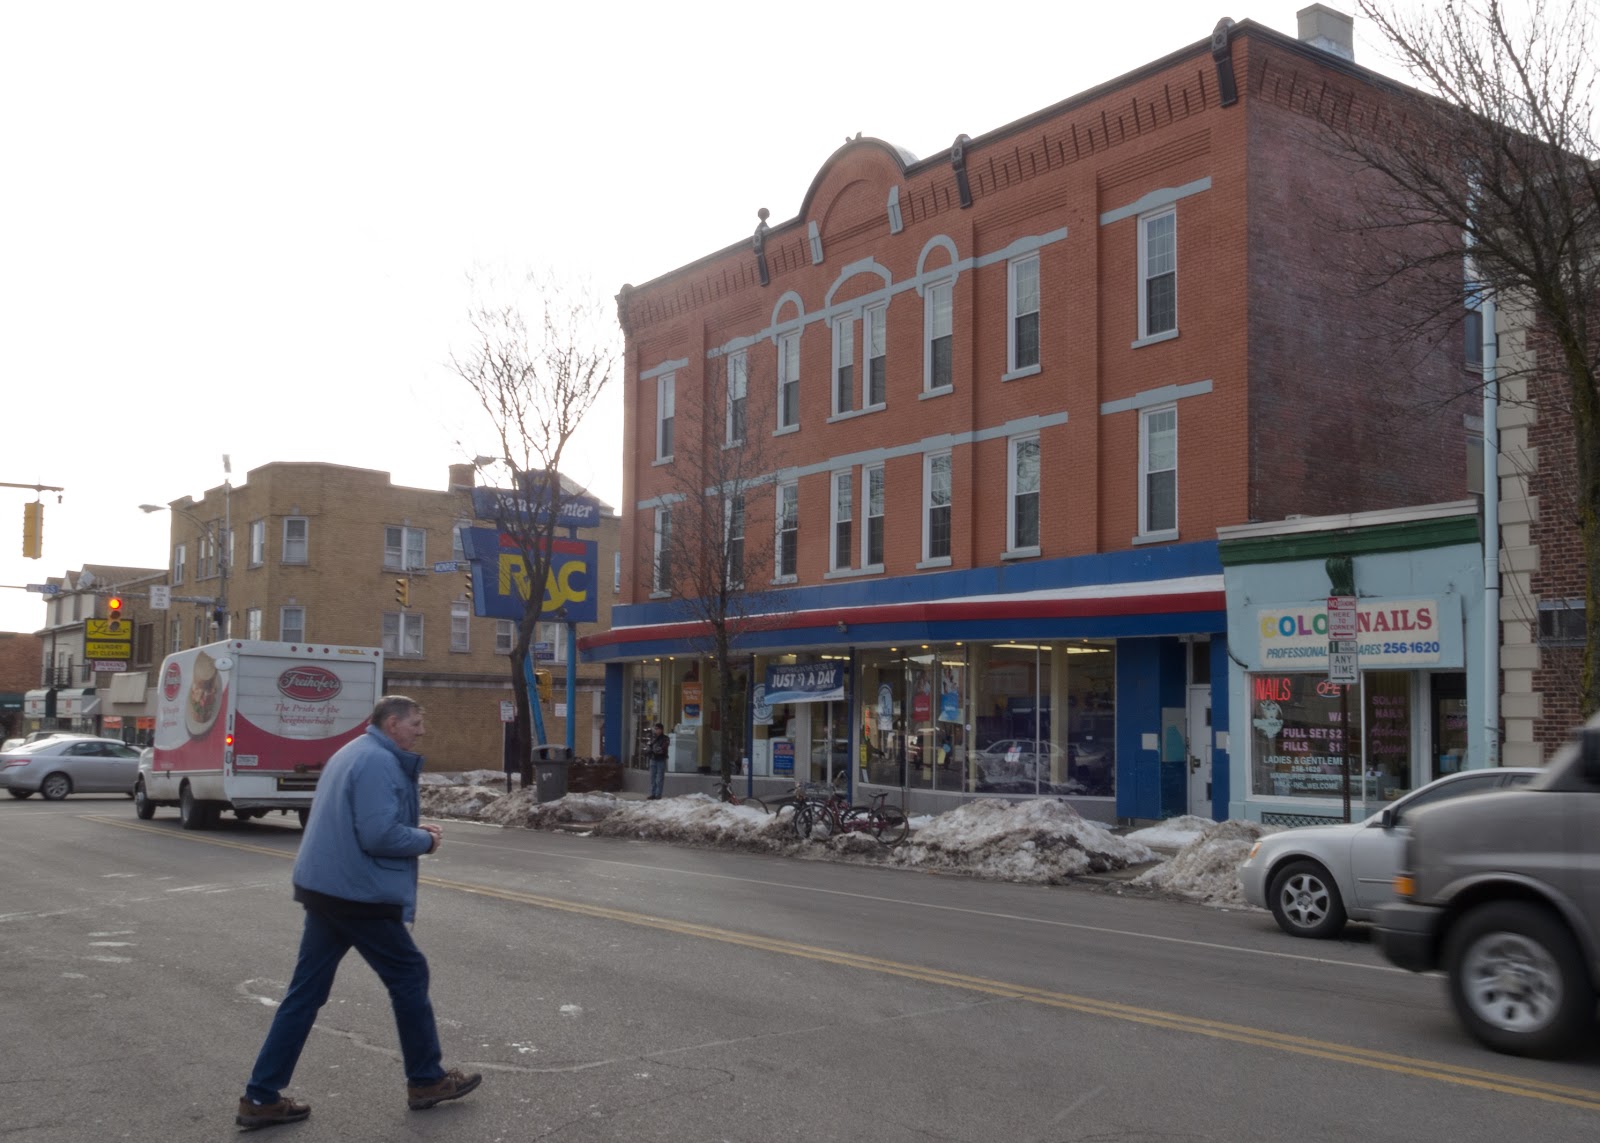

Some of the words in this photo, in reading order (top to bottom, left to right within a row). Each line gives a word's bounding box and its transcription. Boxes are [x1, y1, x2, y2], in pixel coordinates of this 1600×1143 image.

[498, 553, 587, 612] RAC
[1328, 599, 1338, 608] NO
[1261, 613, 1328, 638] COLO
[1357, 608, 1433, 633] NAILS
[1266, 646, 1328, 659] PROFESSIONAL
[1357, 644, 1382, 656] ARES
[1383, 641, 1441, 654] 256-1620
[1334, 655, 1352, 664] ANY
[1333, 665, 1354, 674] TIME
[772, 674, 796, 688] JUST
[807, 671, 815, 686] A
[817, 669, 837, 685] DAY
[1255, 677, 1291, 701] NAILS
[1372, 696, 1406, 705] SOLAR
[275, 703, 290, 712] The
[292, 704, 313, 713] Pride
[316, 705, 326, 714] of
[326, 705, 340, 714] the
[1283, 728, 1307, 738] FULL
[1309, 728, 1328, 739] SET
[1329, 729, 1342, 739] $2
[1283, 742, 1309, 751] FILLS
[1329, 742, 1342, 752] $1
[1263, 755, 1292, 764] LADIES
[1294, 757, 1300, 765] &
